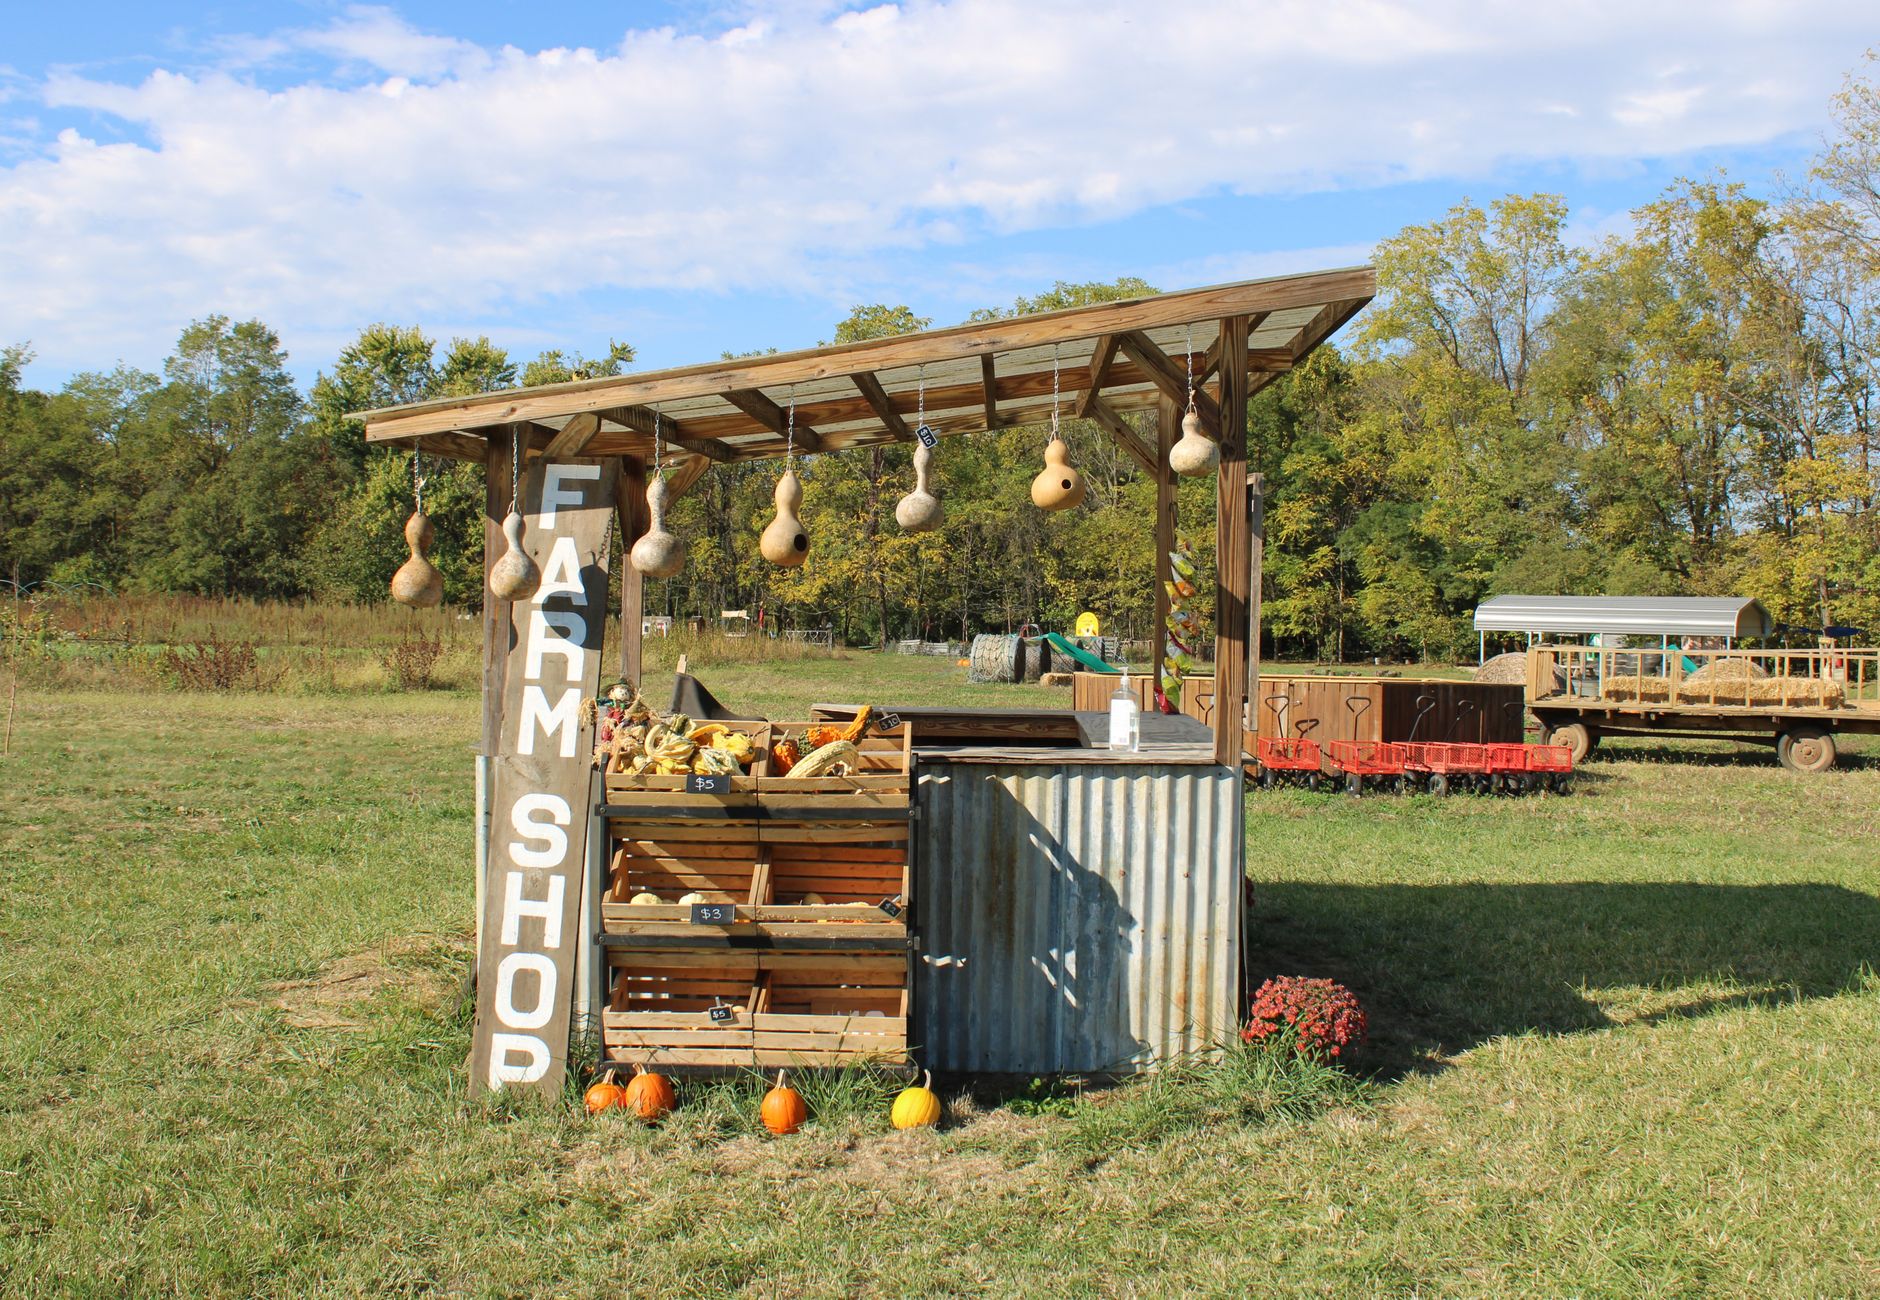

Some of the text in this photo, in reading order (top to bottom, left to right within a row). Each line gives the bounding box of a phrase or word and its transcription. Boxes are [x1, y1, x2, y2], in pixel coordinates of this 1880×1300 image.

[488, 463, 601, 1092] FARM SHOP
[695, 776, 715, 791] $5
[700, 907, 722, 920] $3
[712, 1010, 726, 1019] $5
